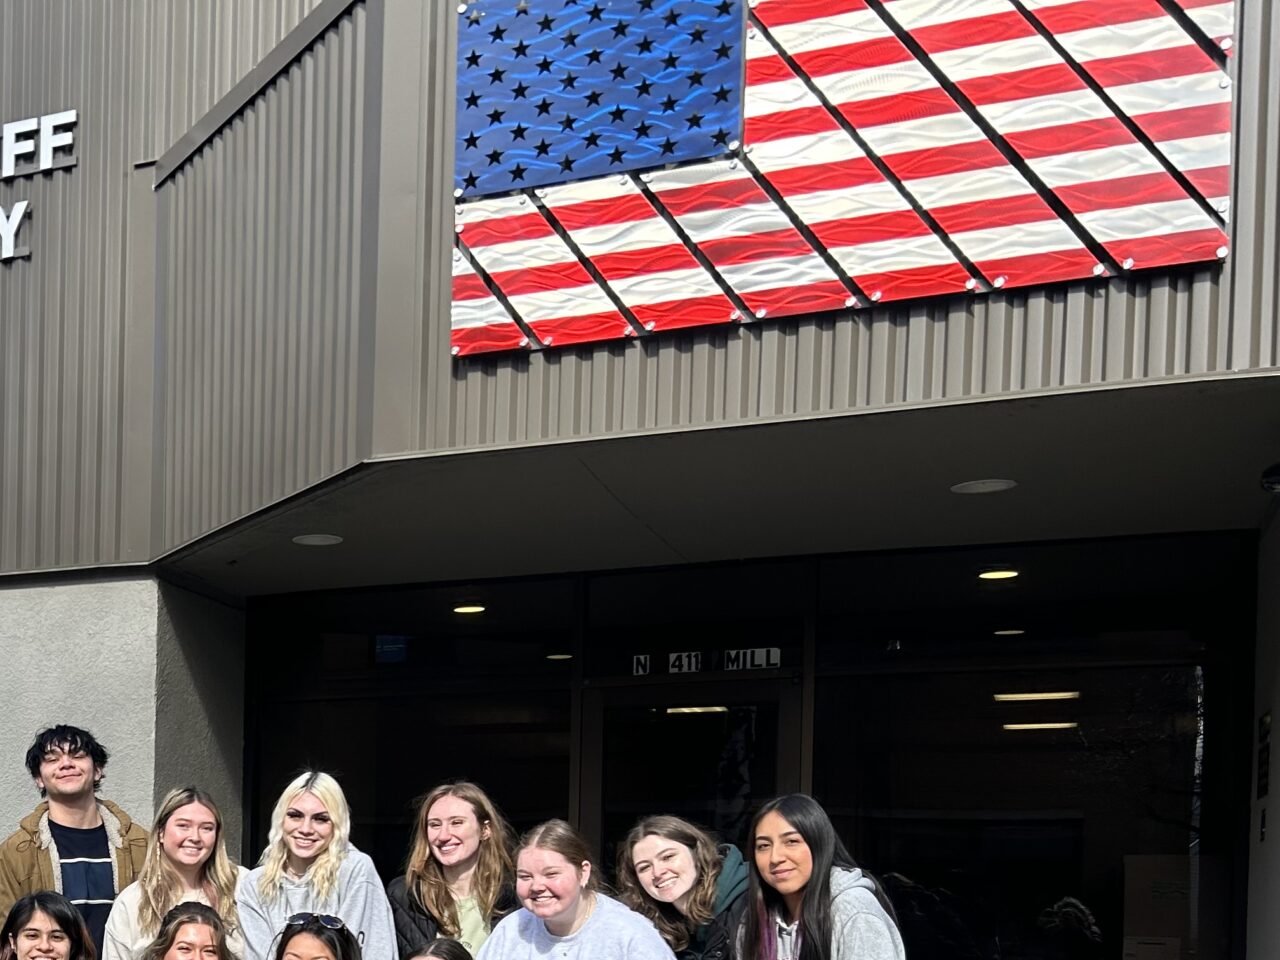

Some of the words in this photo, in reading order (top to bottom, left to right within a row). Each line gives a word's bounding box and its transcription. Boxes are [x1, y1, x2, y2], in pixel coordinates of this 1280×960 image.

[634, 655, 649, 675] N
[670, 652, 700, 672] 411
[725, 648, 780, 670] MILL
